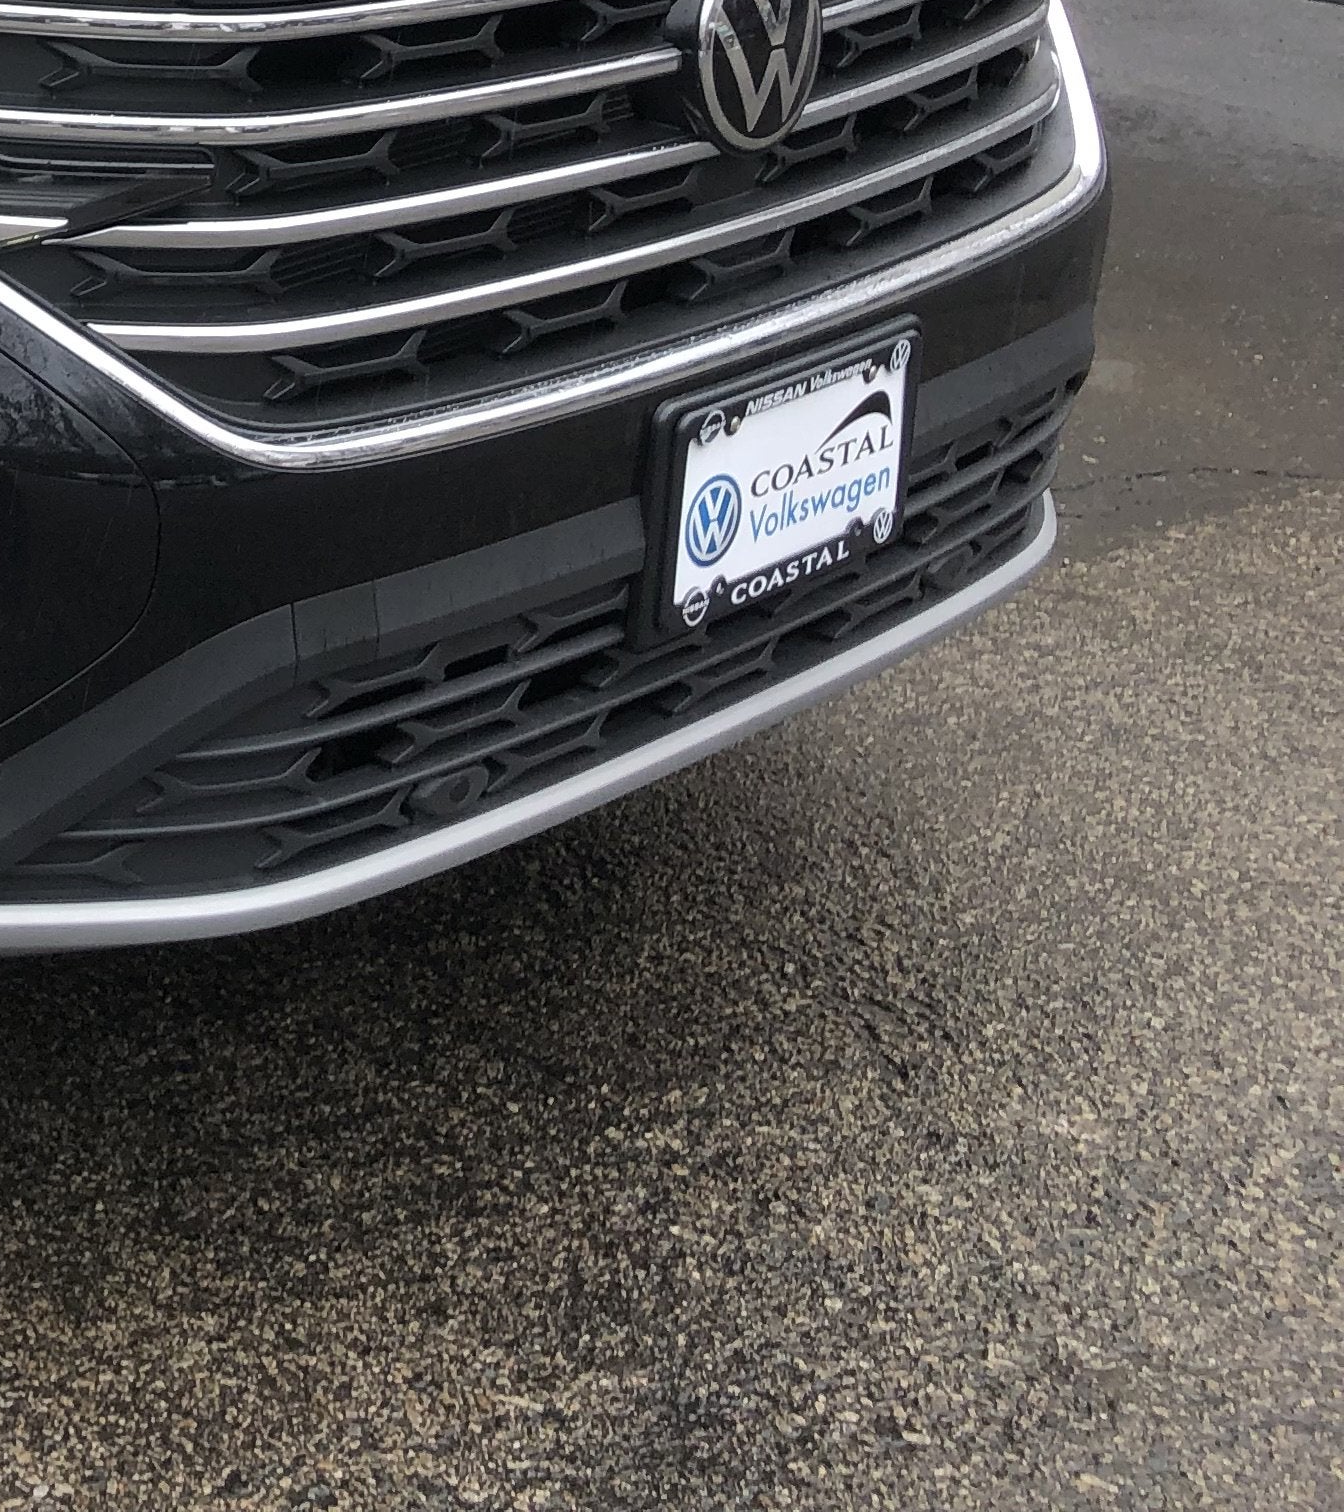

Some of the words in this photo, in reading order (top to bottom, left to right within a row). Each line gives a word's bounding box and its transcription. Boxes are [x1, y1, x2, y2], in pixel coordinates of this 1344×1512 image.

[745, 382, 808, 416] NISSAN
[750, 424, 894, 498] COASTAL
[749, 466, 891, 543] Volkswagen
[730, 540, 850, 605] COASTAL
